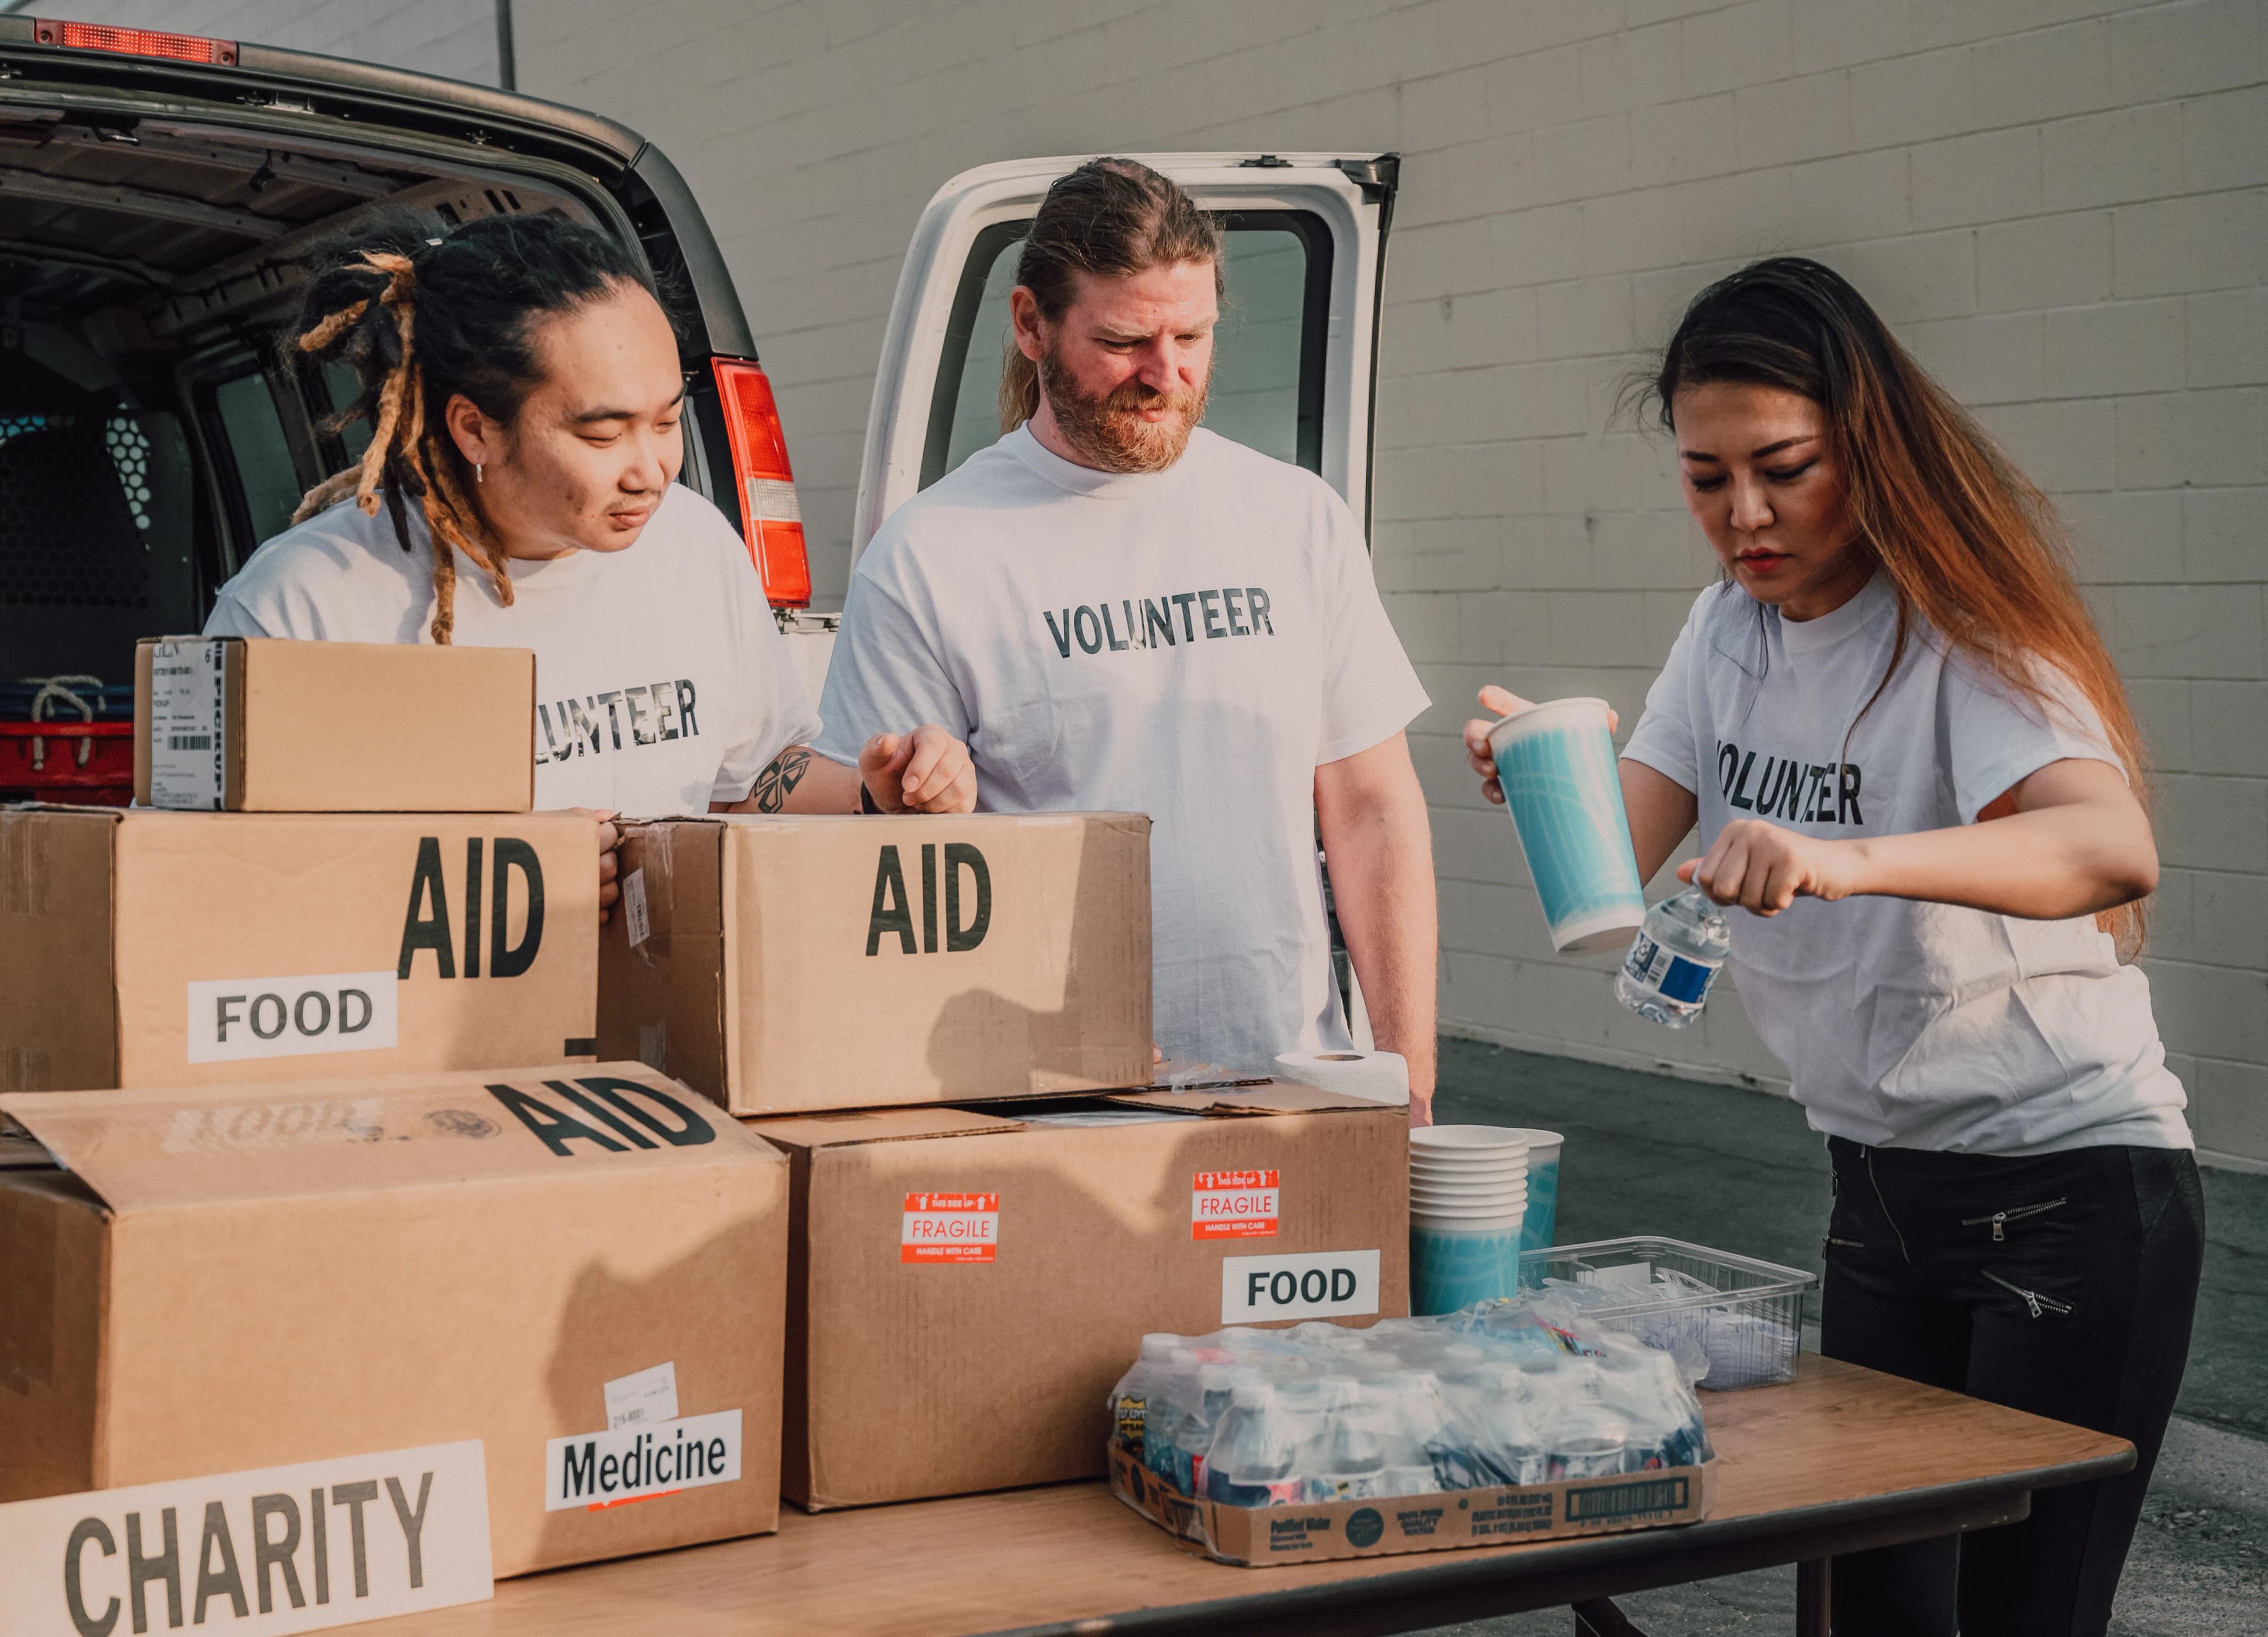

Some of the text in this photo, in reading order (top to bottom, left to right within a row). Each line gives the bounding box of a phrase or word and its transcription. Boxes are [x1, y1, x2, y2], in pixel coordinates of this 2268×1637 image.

[1043, 588, 1275, 658] VOLUNTEER
[536, 679, 699, 765] UNTEER
[398, 837, 546, 980] AID
[866, 842, 991, 957] AID
[217, 989, 373, 1042] FOOD
[484, 1077, 716, 1157] AID
[912, 1219, 990, 1238] FRAGILE
[1201, 1195, 1272, 1215] FRAGILE
[1205, 1223, 1230, 1231] HANDLE
[1247, 1221, 1265, 1230] CARE
[916, 1247, 982, 1256] HANDLE WITH CARE
[1248, 1268, 1357, 1307] FOOD
[562, 1429, 726, 1499] Medicine
[64, 1471, 434, 1637] CHARITY
